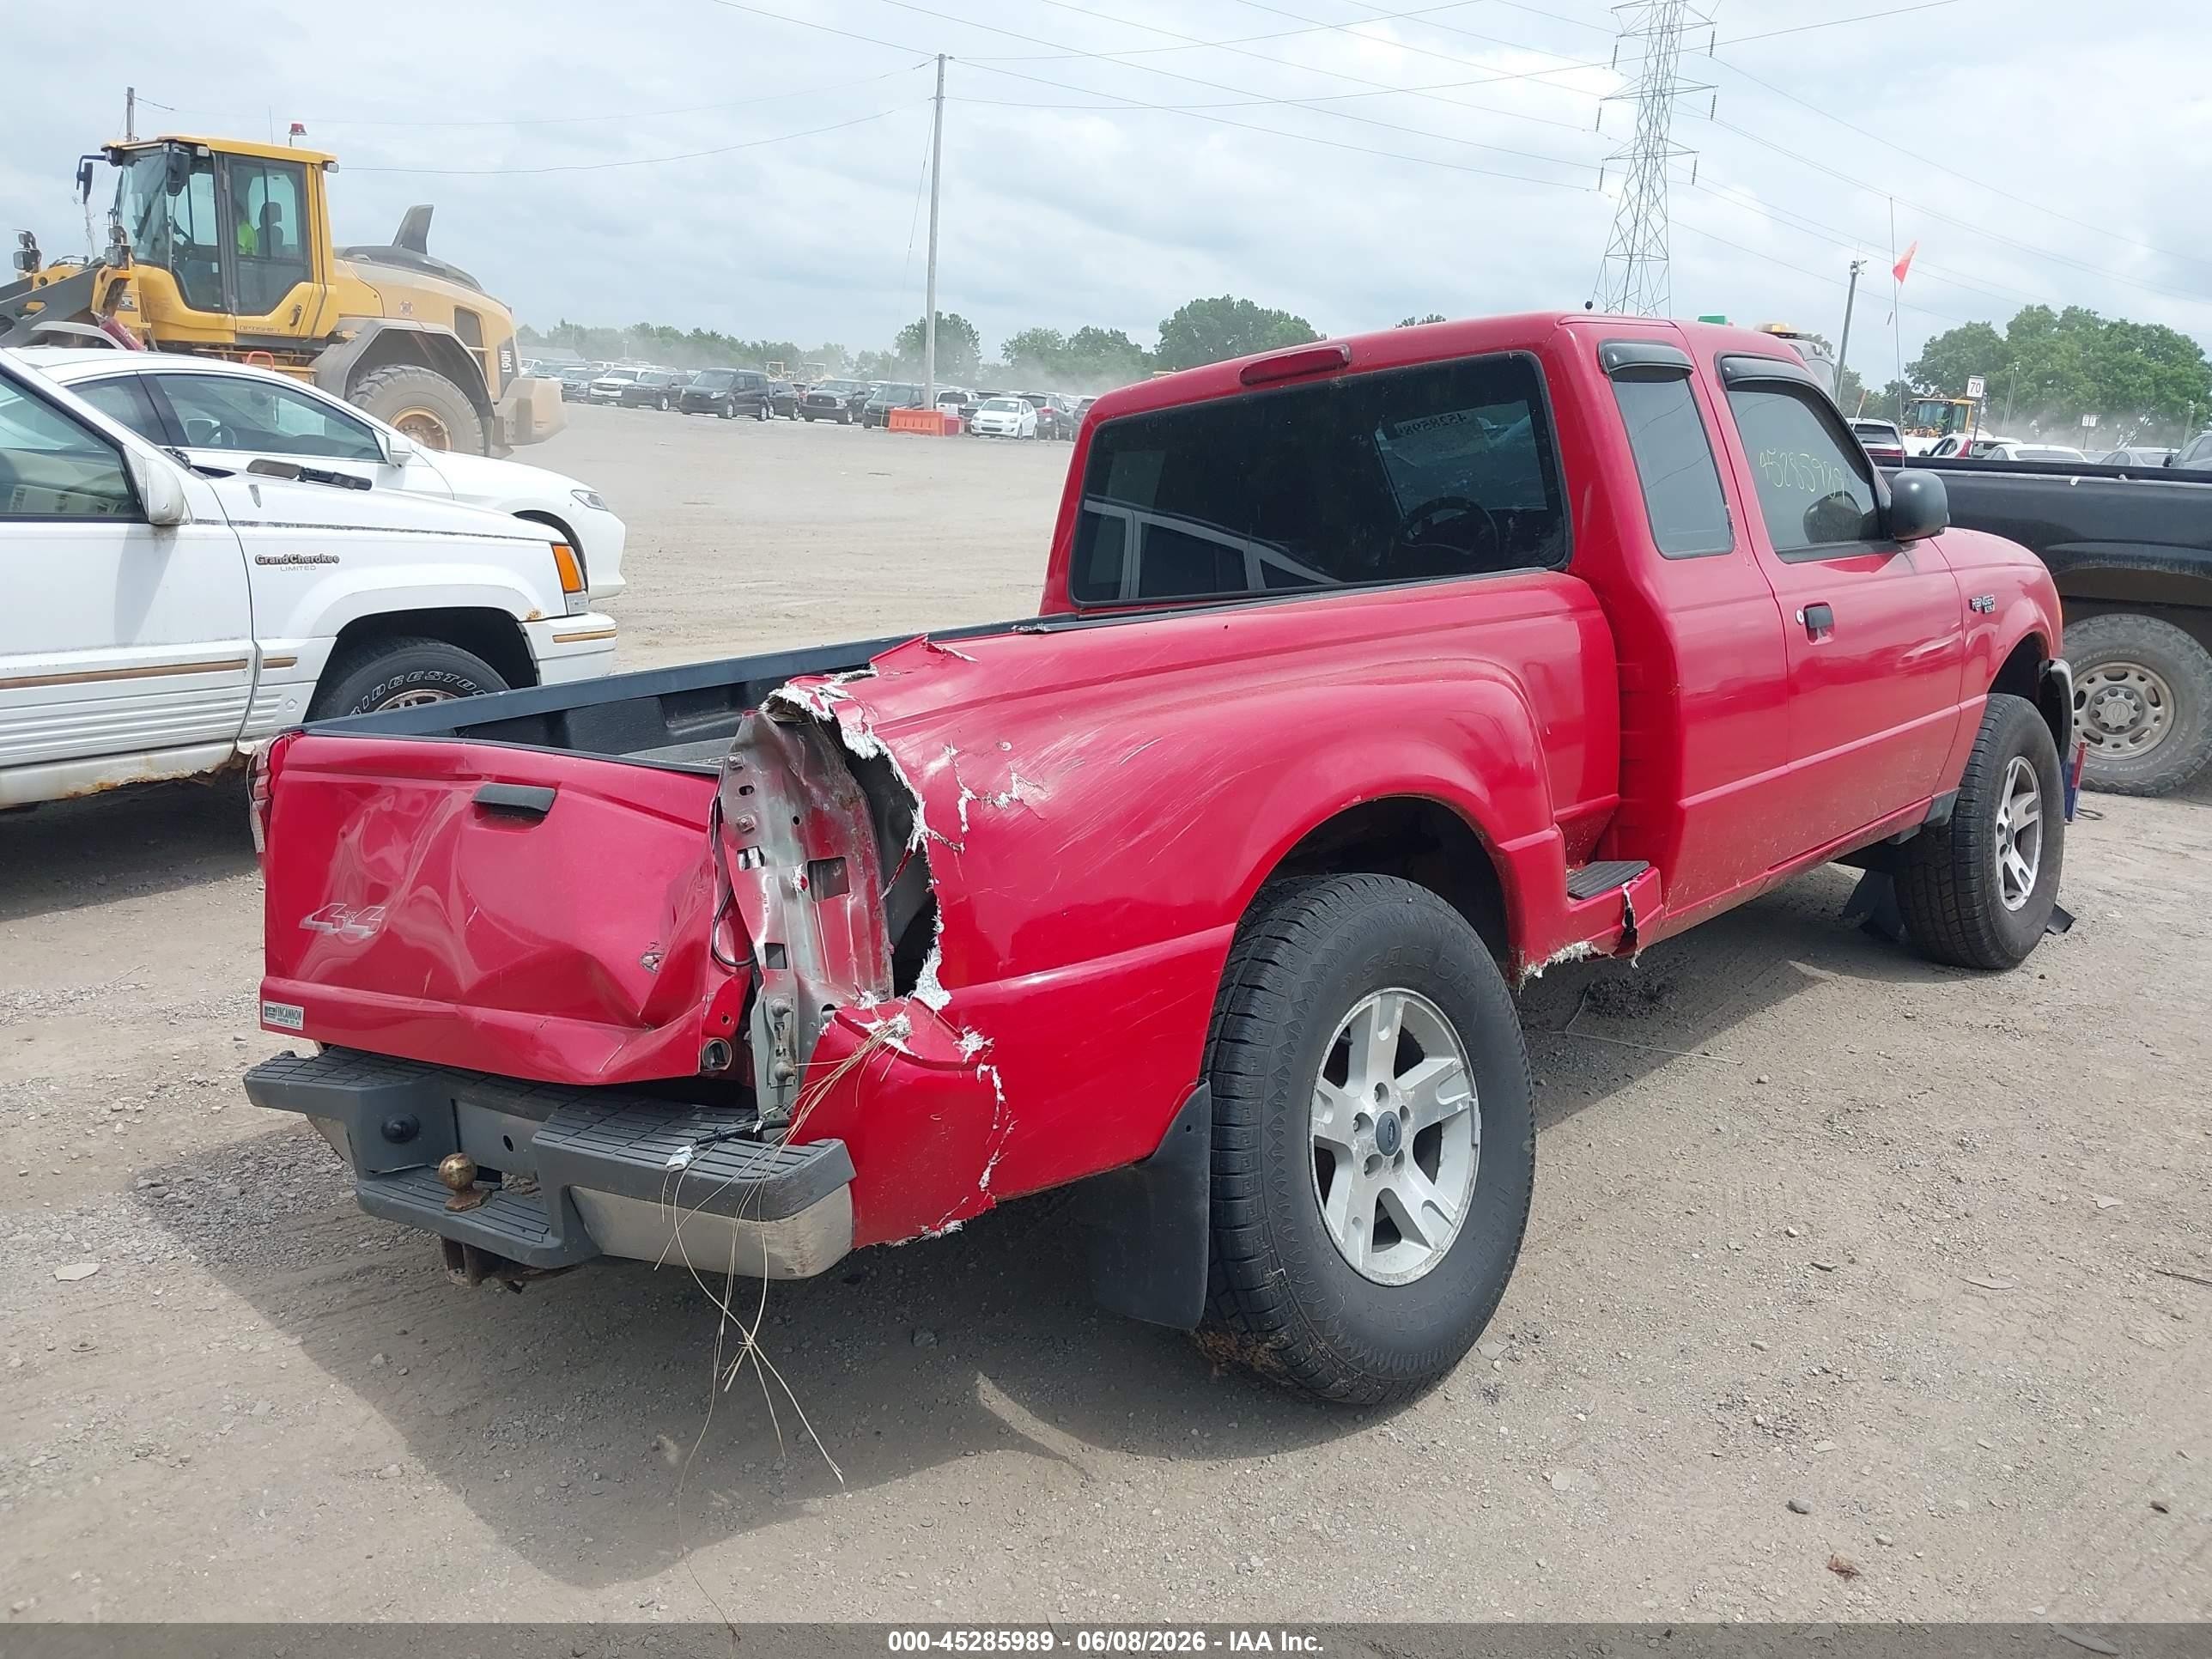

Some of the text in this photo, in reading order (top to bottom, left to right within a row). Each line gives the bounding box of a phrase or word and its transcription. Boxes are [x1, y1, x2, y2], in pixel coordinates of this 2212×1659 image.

[501, 350, 512, 373] L90H
[1968, 381, 1981, 393] 70
[1759, 448, 1845, 505] 45285989
[1969, 595, 1995, 610] RANGER
